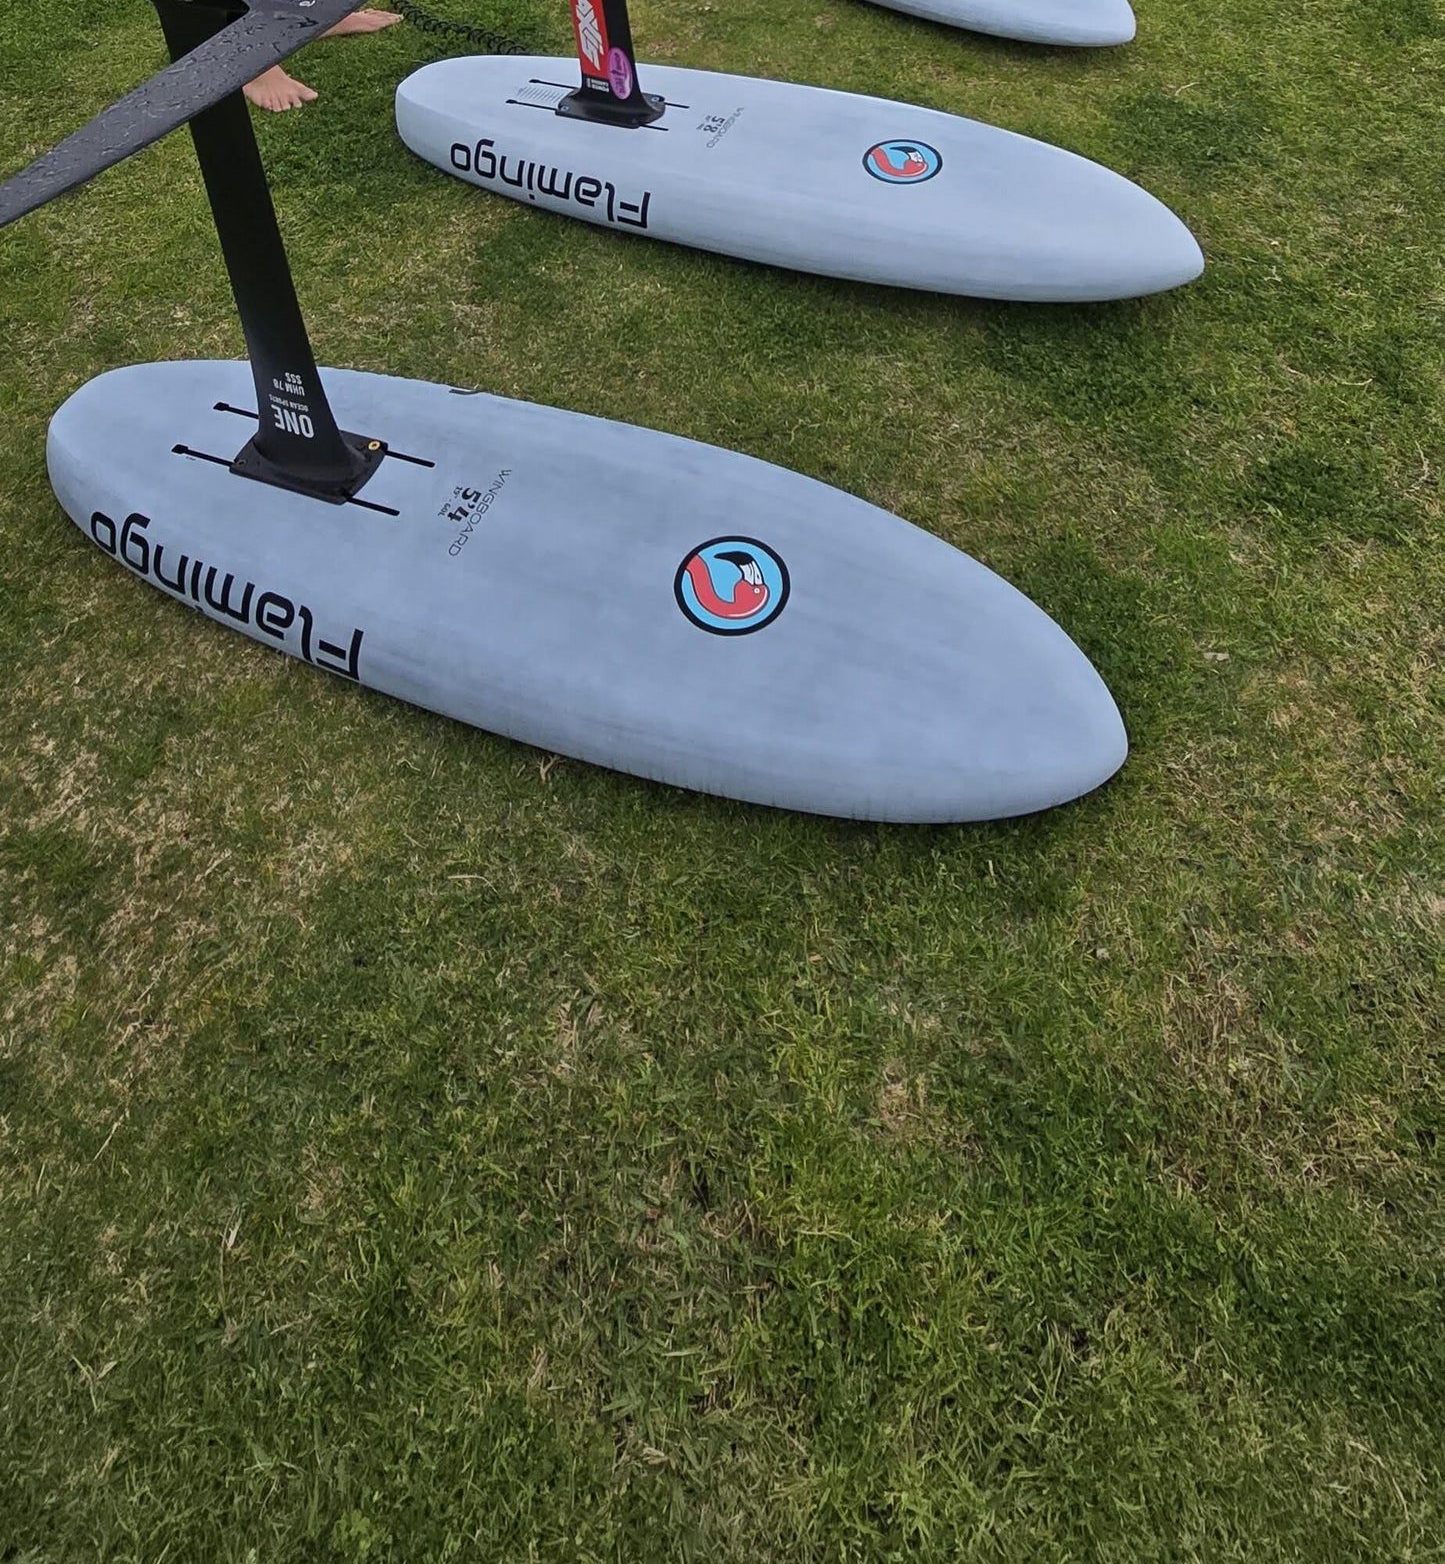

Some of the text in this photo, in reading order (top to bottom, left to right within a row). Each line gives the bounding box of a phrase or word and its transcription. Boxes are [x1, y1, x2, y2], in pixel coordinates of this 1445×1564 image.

[450, 138, 651, 229] Flamingo
[285, 372, 302, 385] SSS
[285, 382, 305, 397] UHM
[271, 404, 315, 439] ONE
[448, 469, 512, 557] WINGBOARD
[90, 511, 365, 681] Flamingo
